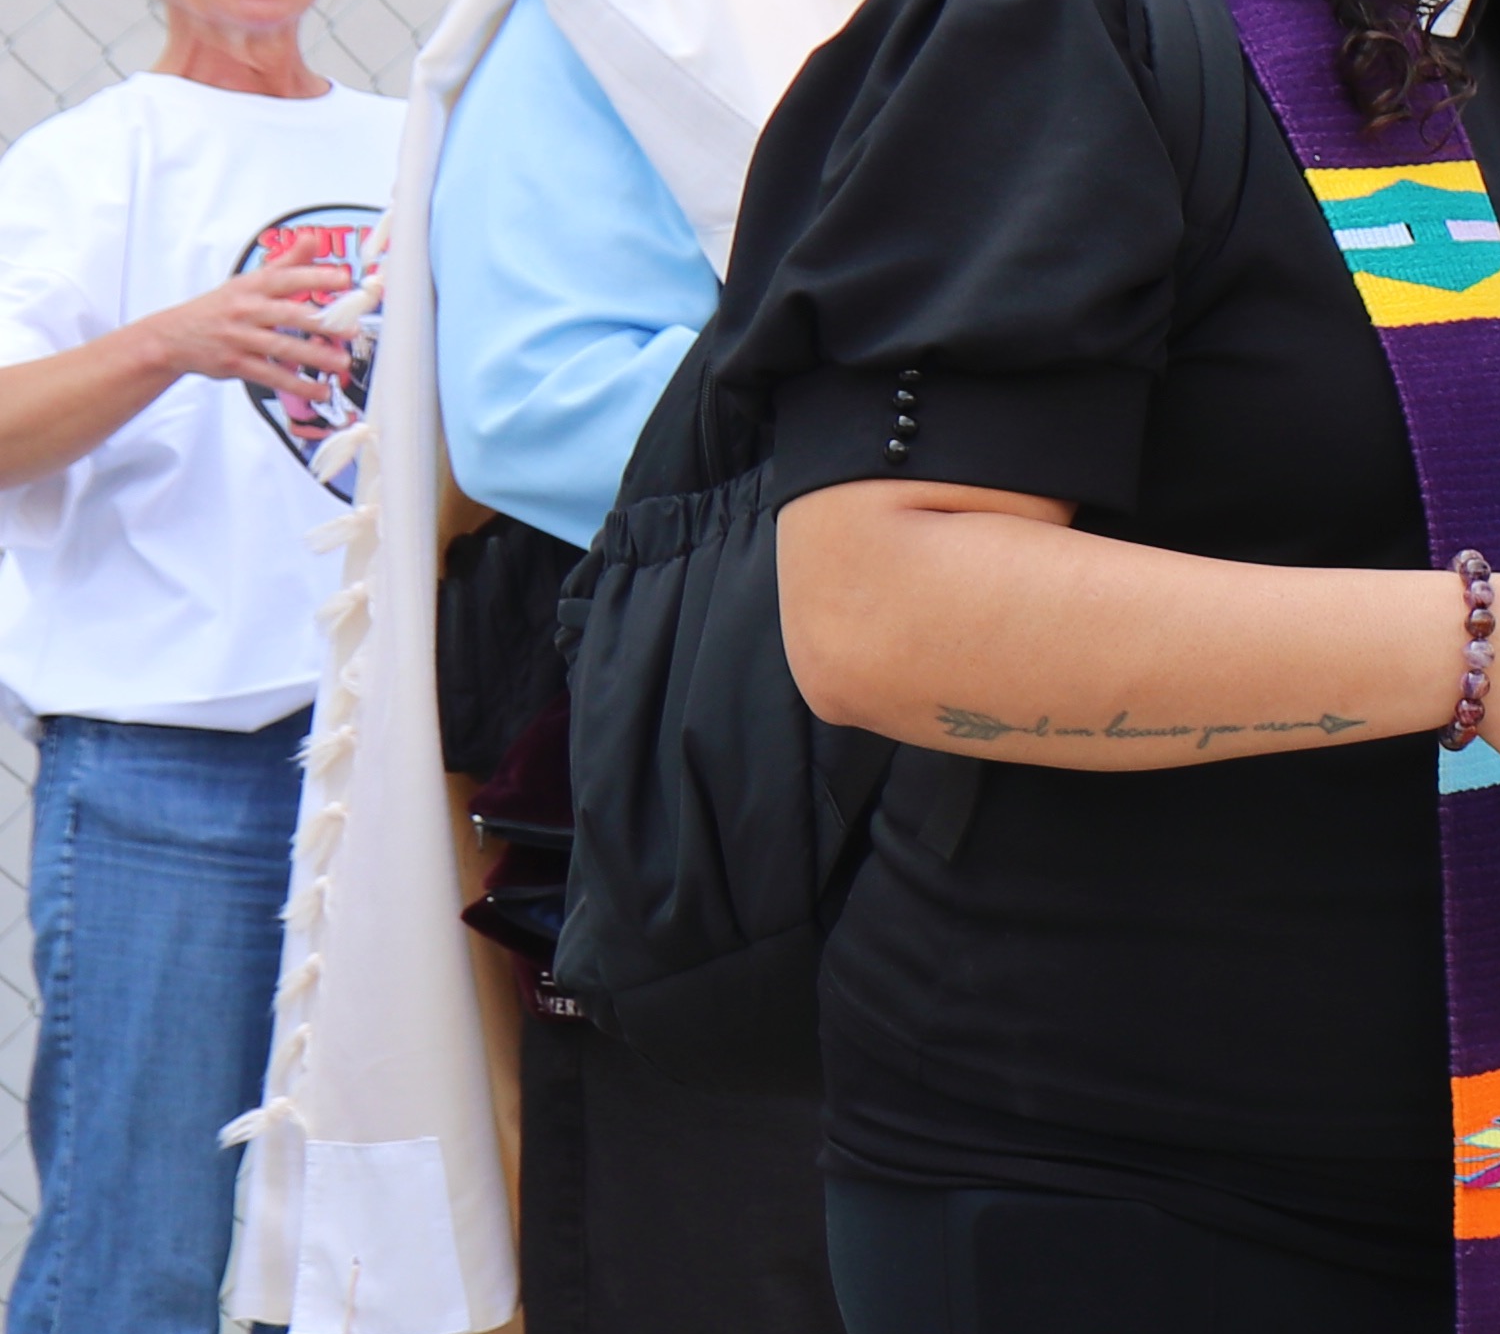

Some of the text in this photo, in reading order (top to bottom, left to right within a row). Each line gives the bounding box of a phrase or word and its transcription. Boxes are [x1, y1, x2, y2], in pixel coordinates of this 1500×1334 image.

[1055, 725, 1095, 737] am
[1104, 710, 1197, 738] because
[1196, 723, 1246, 750] you
[1253, 720, 1297, 732] are
